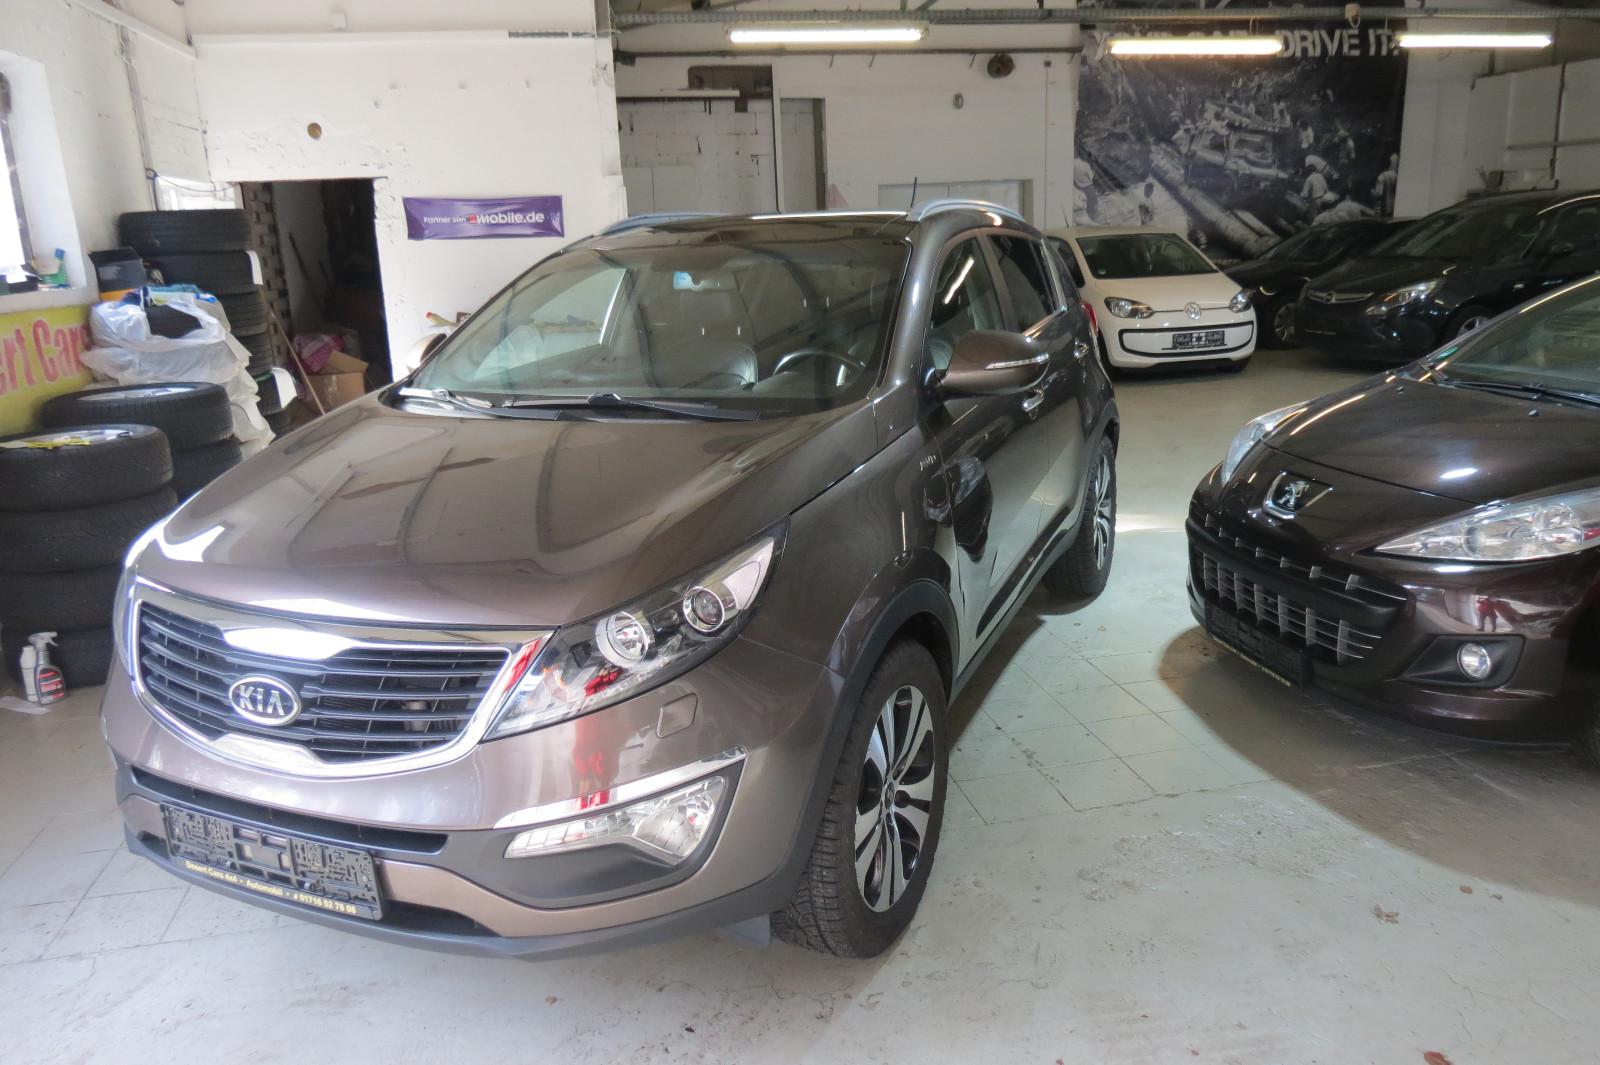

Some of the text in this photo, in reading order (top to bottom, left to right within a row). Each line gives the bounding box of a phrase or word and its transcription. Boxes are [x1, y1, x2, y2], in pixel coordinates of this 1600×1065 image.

[1274, 28, 1360, 58] DRIVE
[477, 211, 545, 224] mobile.de
[239, 685, 285, 716] KIA
